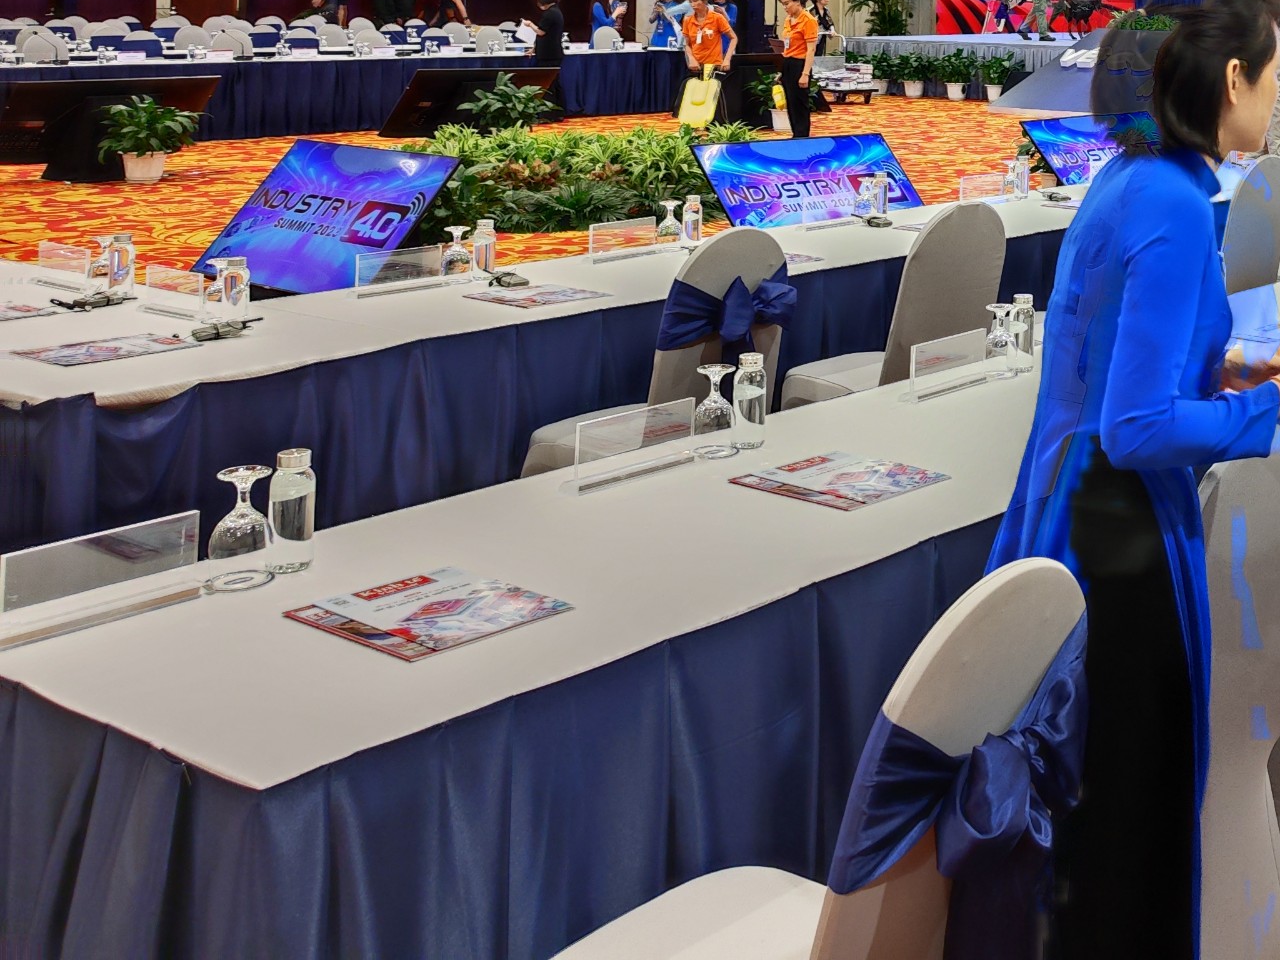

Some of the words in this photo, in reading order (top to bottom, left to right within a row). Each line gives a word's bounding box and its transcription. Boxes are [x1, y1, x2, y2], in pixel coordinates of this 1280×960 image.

[252, 187, 360, 219] INDUSTRY
[724, 177, 845, 205] INDUSTRY
[782, 199, 829, 213] SUMMIT
[831, 197, 856, 209] 202
[273, 217, 315, 234] SUMMIT
[316, 224, 341, 239] 2023
